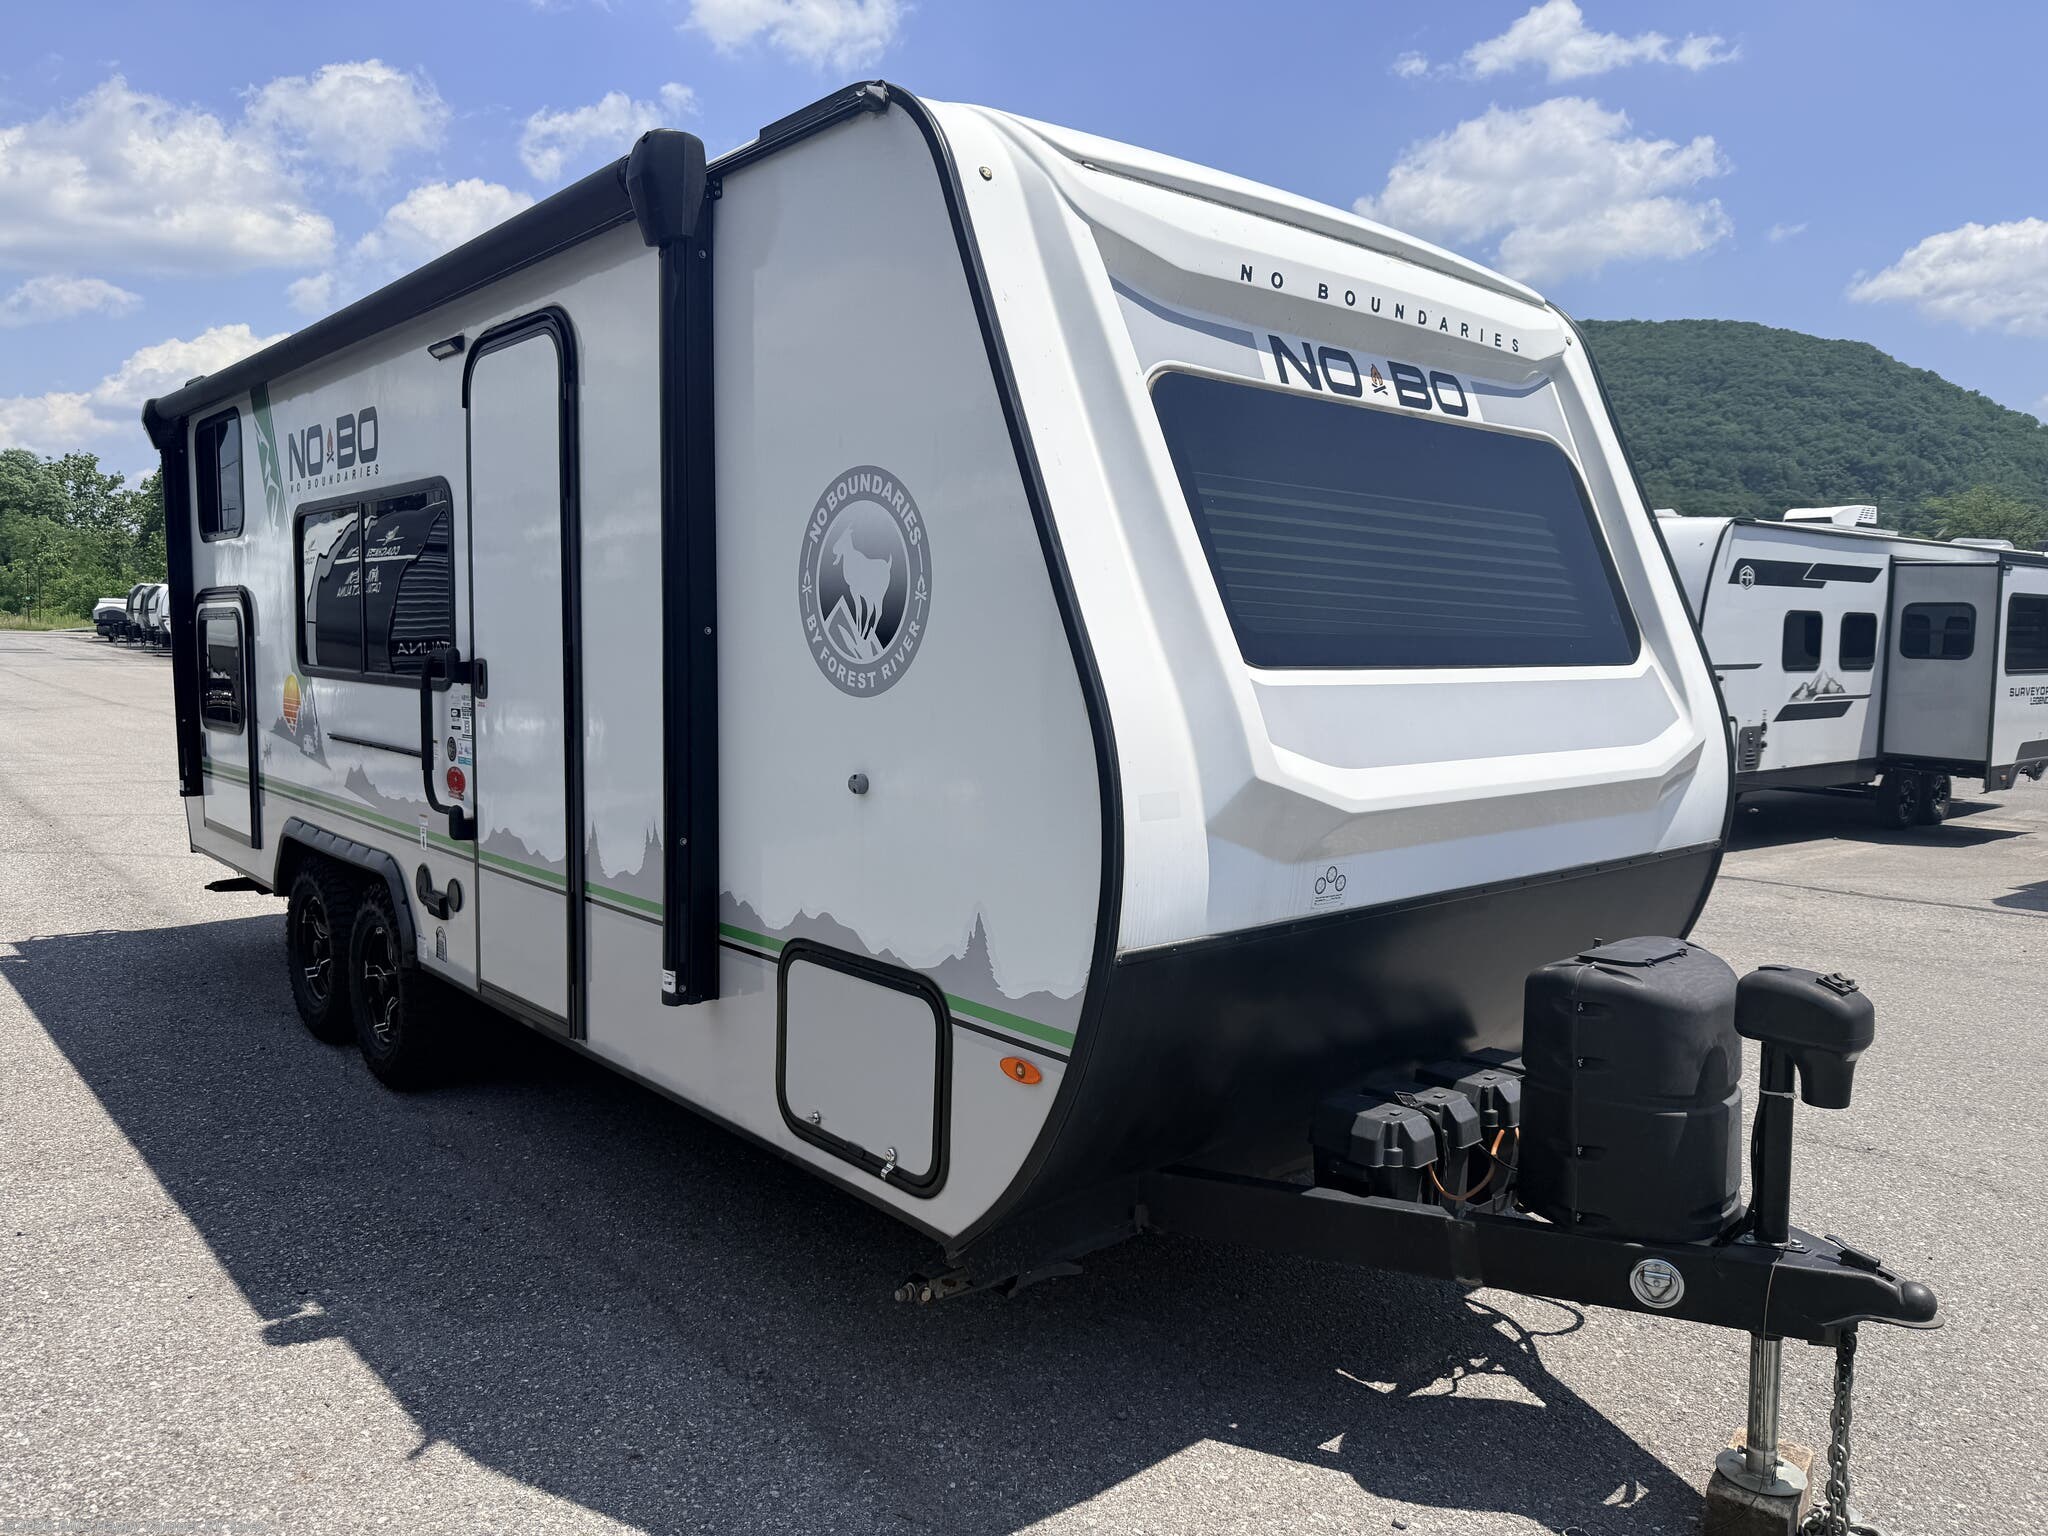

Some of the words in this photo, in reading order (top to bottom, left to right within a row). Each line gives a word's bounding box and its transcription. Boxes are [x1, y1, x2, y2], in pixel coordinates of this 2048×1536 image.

[1240, 263, 1284, 289] NO
[1317, 282, 1520, 353] BOUNDARIES
[307, 463, 379, 490] BOUNDARIES
[809, 507, 828, 544] NO
[826, 473, 922, 546] BOUNDARIES
[806, 613, 823, 645] BY
[819, 646, 876, 689] FOREST
[880, 620, 921, 681] RIVER
